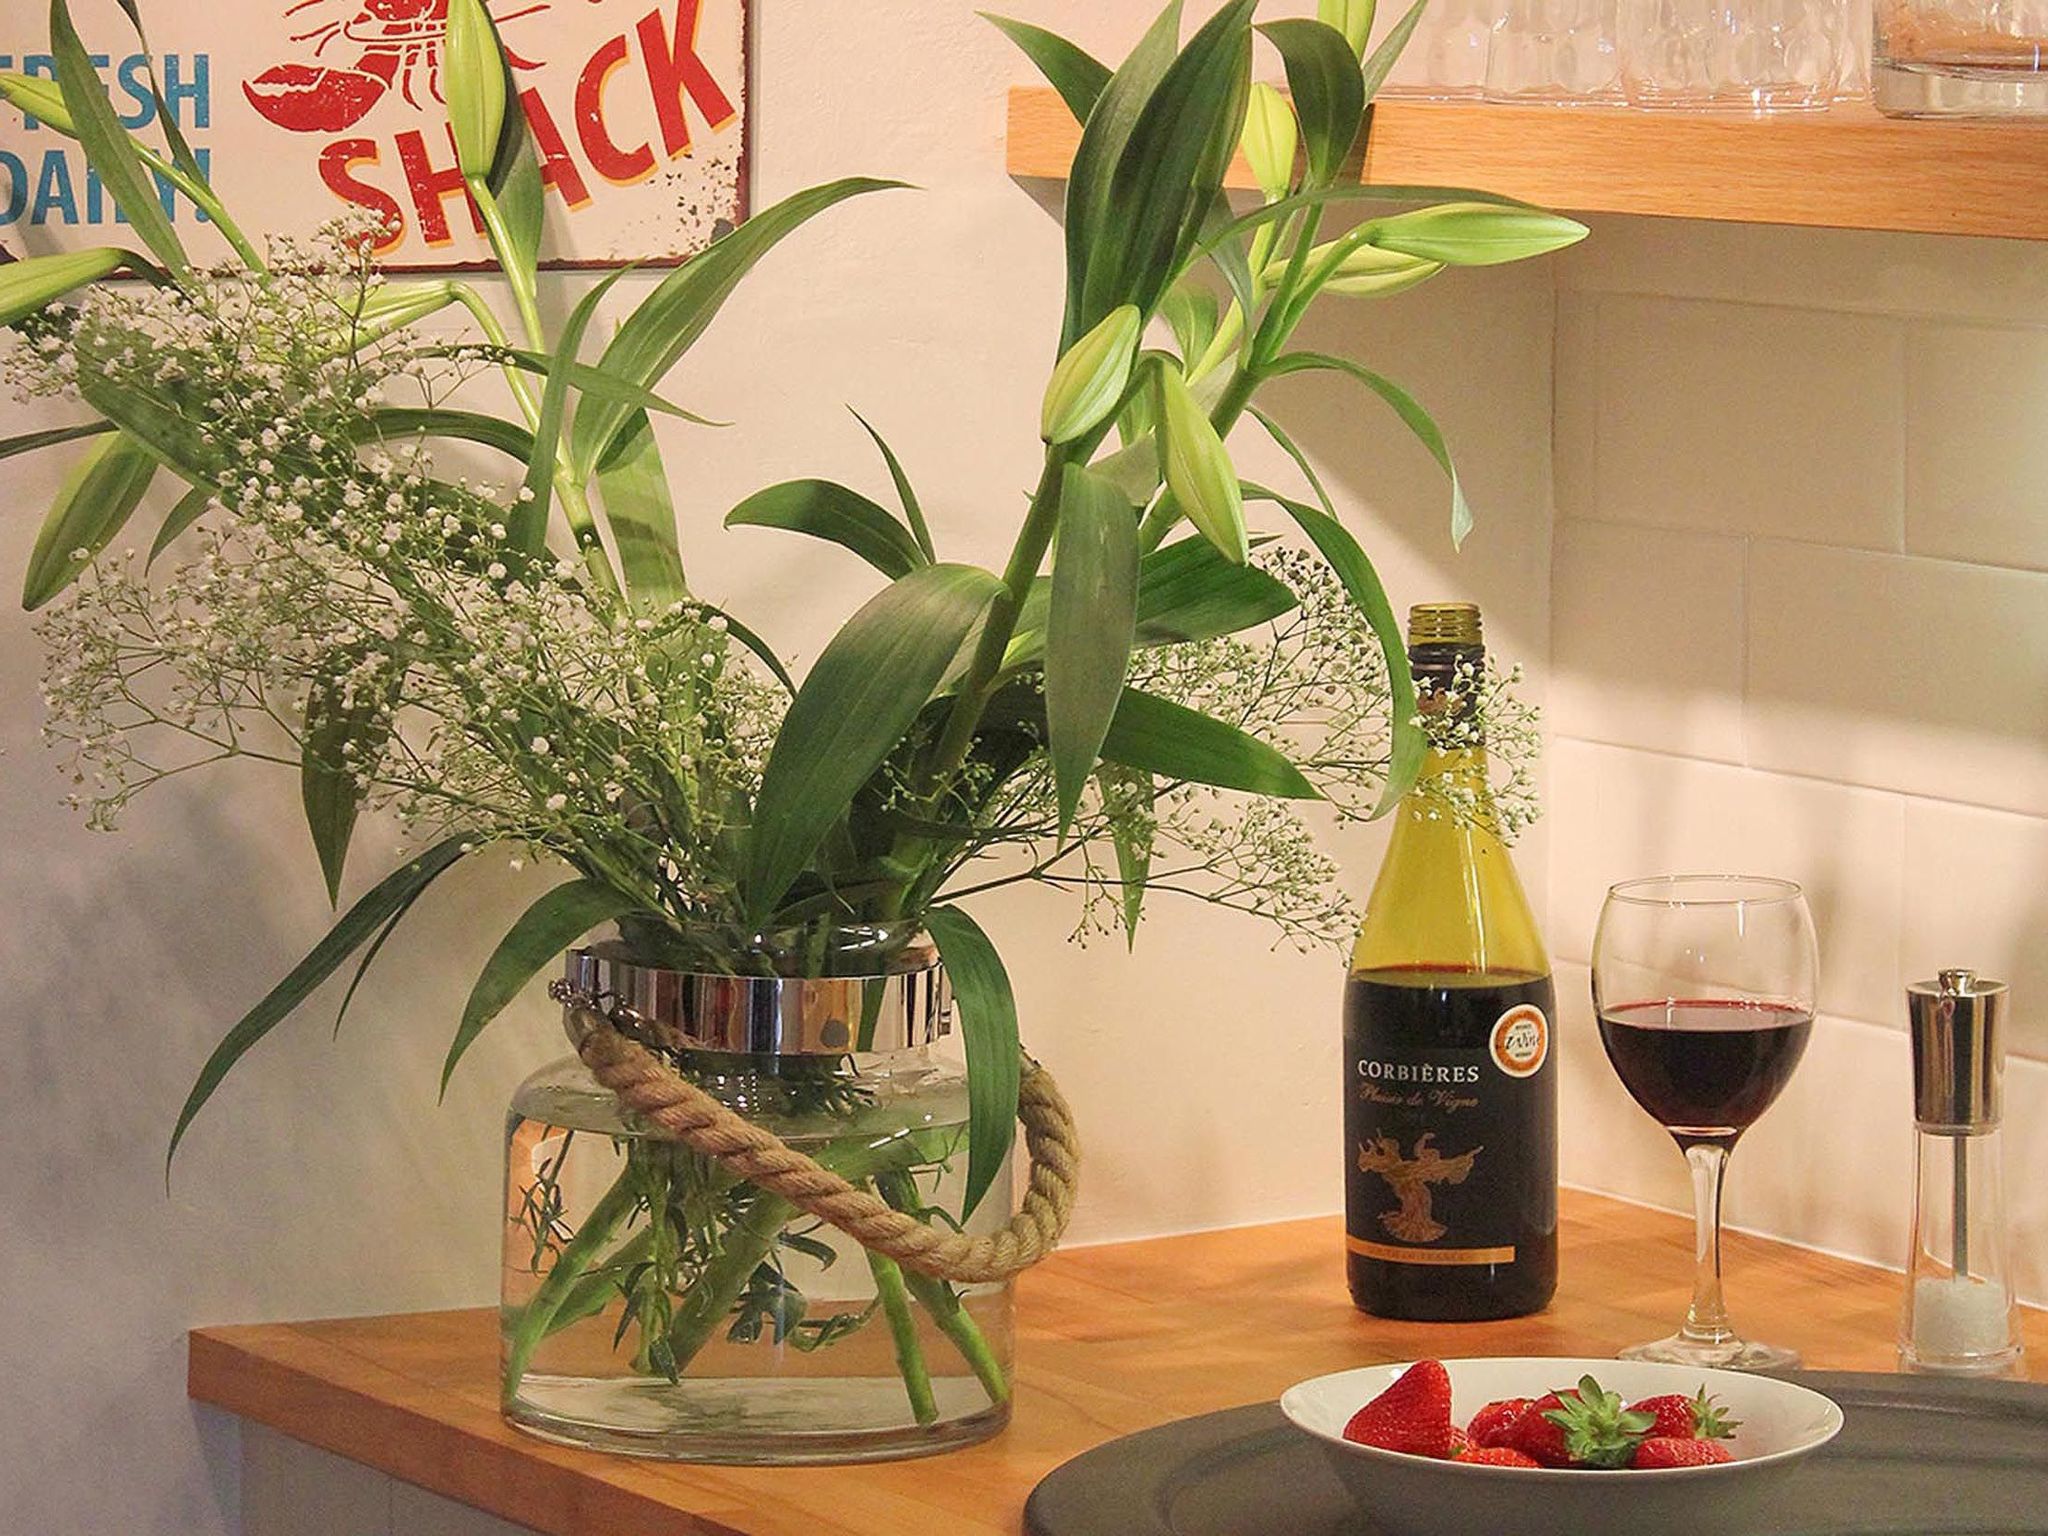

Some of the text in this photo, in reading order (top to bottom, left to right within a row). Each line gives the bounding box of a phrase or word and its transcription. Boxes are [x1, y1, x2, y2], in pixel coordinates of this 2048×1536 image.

[0, 54, 209, 130] RSH
[0, 148, 210, 225] DAIY!
[1358, 1059, 1480, 1083] CORBIÈRES
